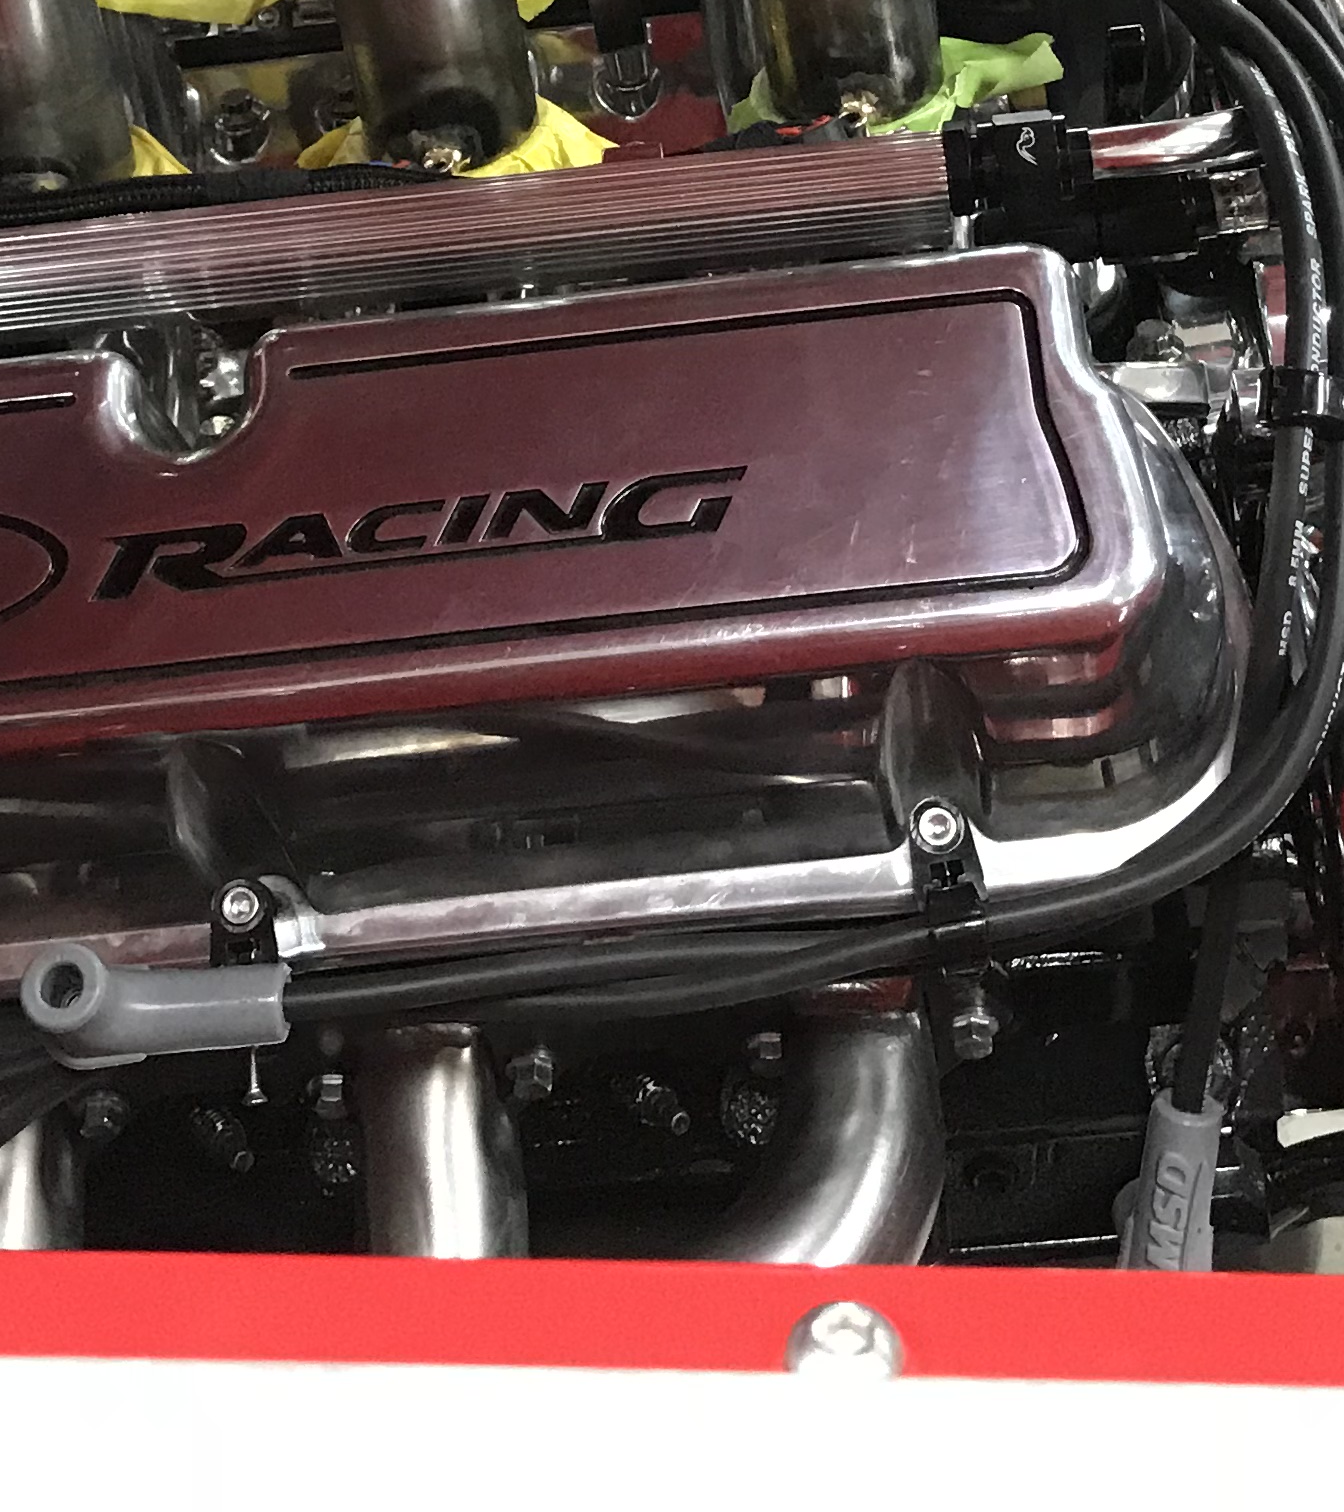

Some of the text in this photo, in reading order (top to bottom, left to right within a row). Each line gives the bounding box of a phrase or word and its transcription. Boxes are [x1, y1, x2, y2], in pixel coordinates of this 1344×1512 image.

[1274, 109, 1299, 157] PLUG
[1294, 169, 1318, 240] SPARK
[1310, 257, 1324, 373] ONDUCTOR
[87, 464, 749, 603] RACING
[1145, 1150, 1190, 1271] MSD
